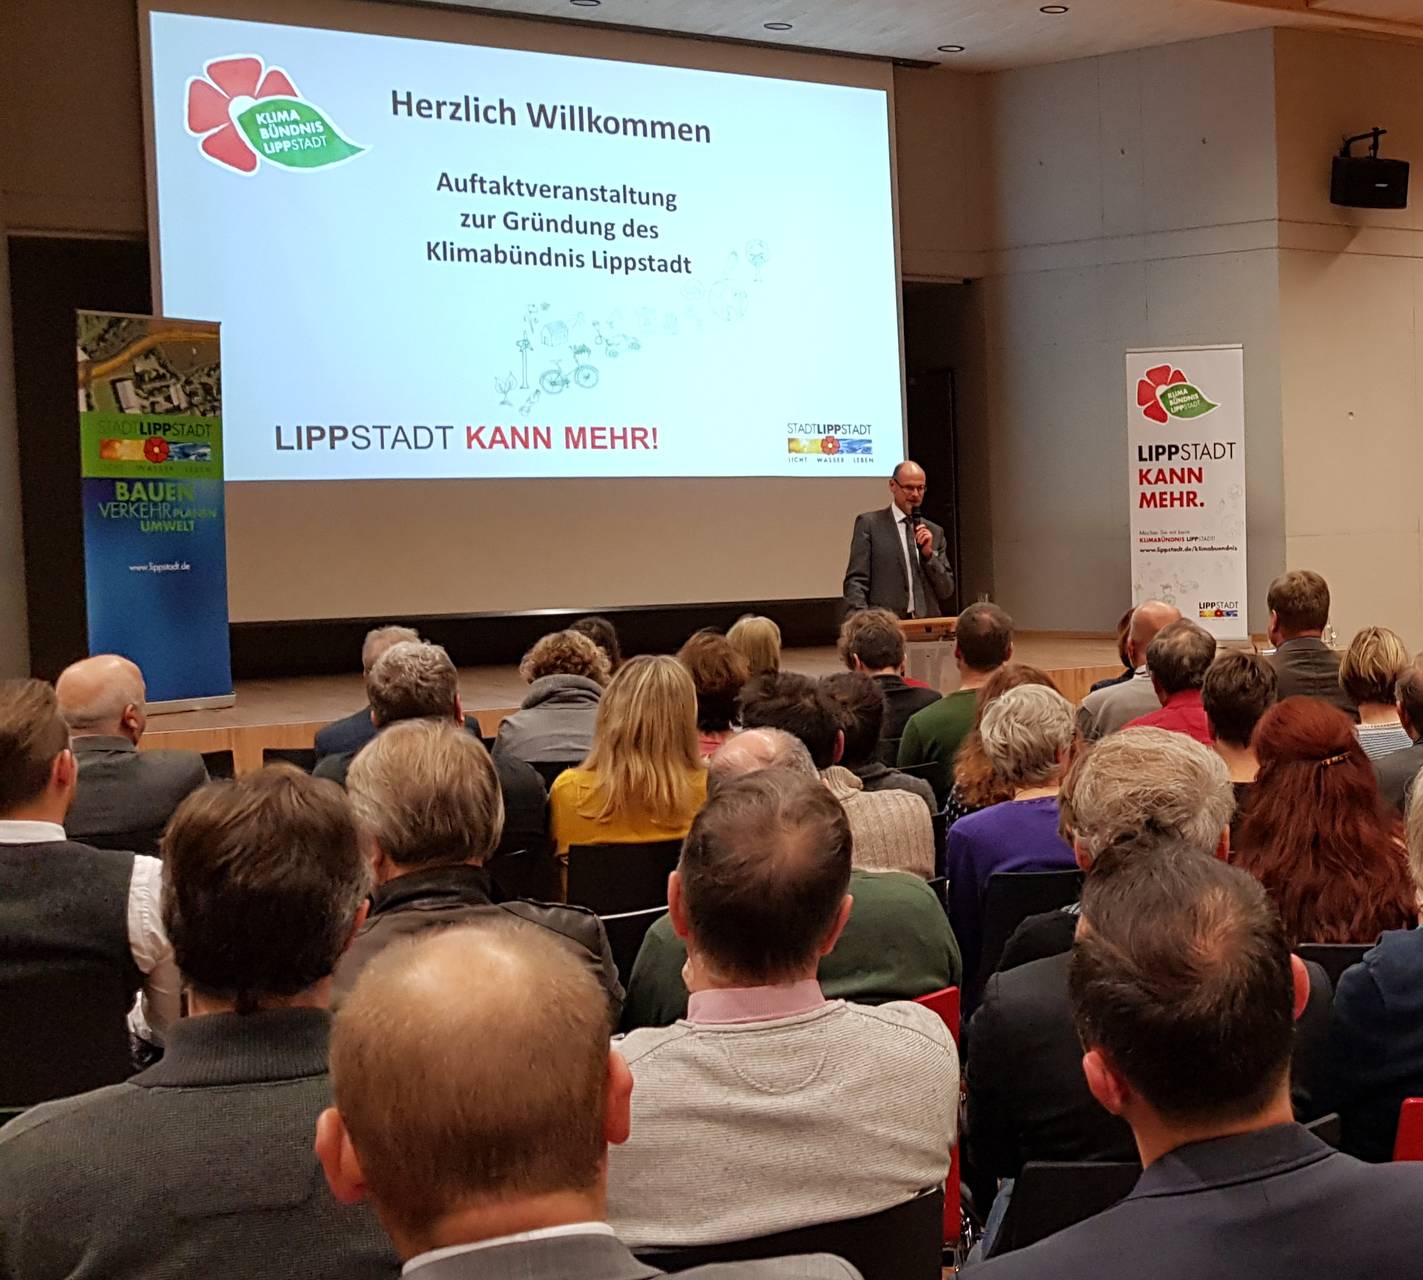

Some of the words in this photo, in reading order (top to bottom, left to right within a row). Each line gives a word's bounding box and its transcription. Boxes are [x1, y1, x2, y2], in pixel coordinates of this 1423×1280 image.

[255, 109, 300, 125] KLIMA
[391, 89, 517, 126] Herzlich
[526, 102, 711, 143] Willkommen
[259, 121, 324, 140] BÜNDNIS
[263, 136, 328, 155] LIPPSTADT
[436, 172, 678, 212] Auftaktveranstaltung
[460, 212, 496, 229] zur
[502, 210, 616, 240] Gründung
[622, 219, 659, 239] des
[426, 241, 586, 268] Klimabündnis
[592, 250, 693, 275] Lippstadt
[98, 420, 212, 437] STADTLIPPSTADT
[275, 424, 454, 451] LIPPSTADT
[465, 425, 552, 450] KANN
[564, 426, 659, 450] MEHR!
[787, 422, 872, 435] STADTLIPPSTADT
[1137, 442, 1237, 462] LIPPSTADT
[1138, 467, 1203, 485] KANN
[115, 481, 195, 501] BAUEN
[1138, 491, 1205, 509] MEHR.
[98, 502, 172, 519] VERKEHR
[140, 520, 195, 533] UMWELT
[129, 561, 191, 574] www.lippstadt.de
[1198, 600, 1239, 610] LIPPSTADT
